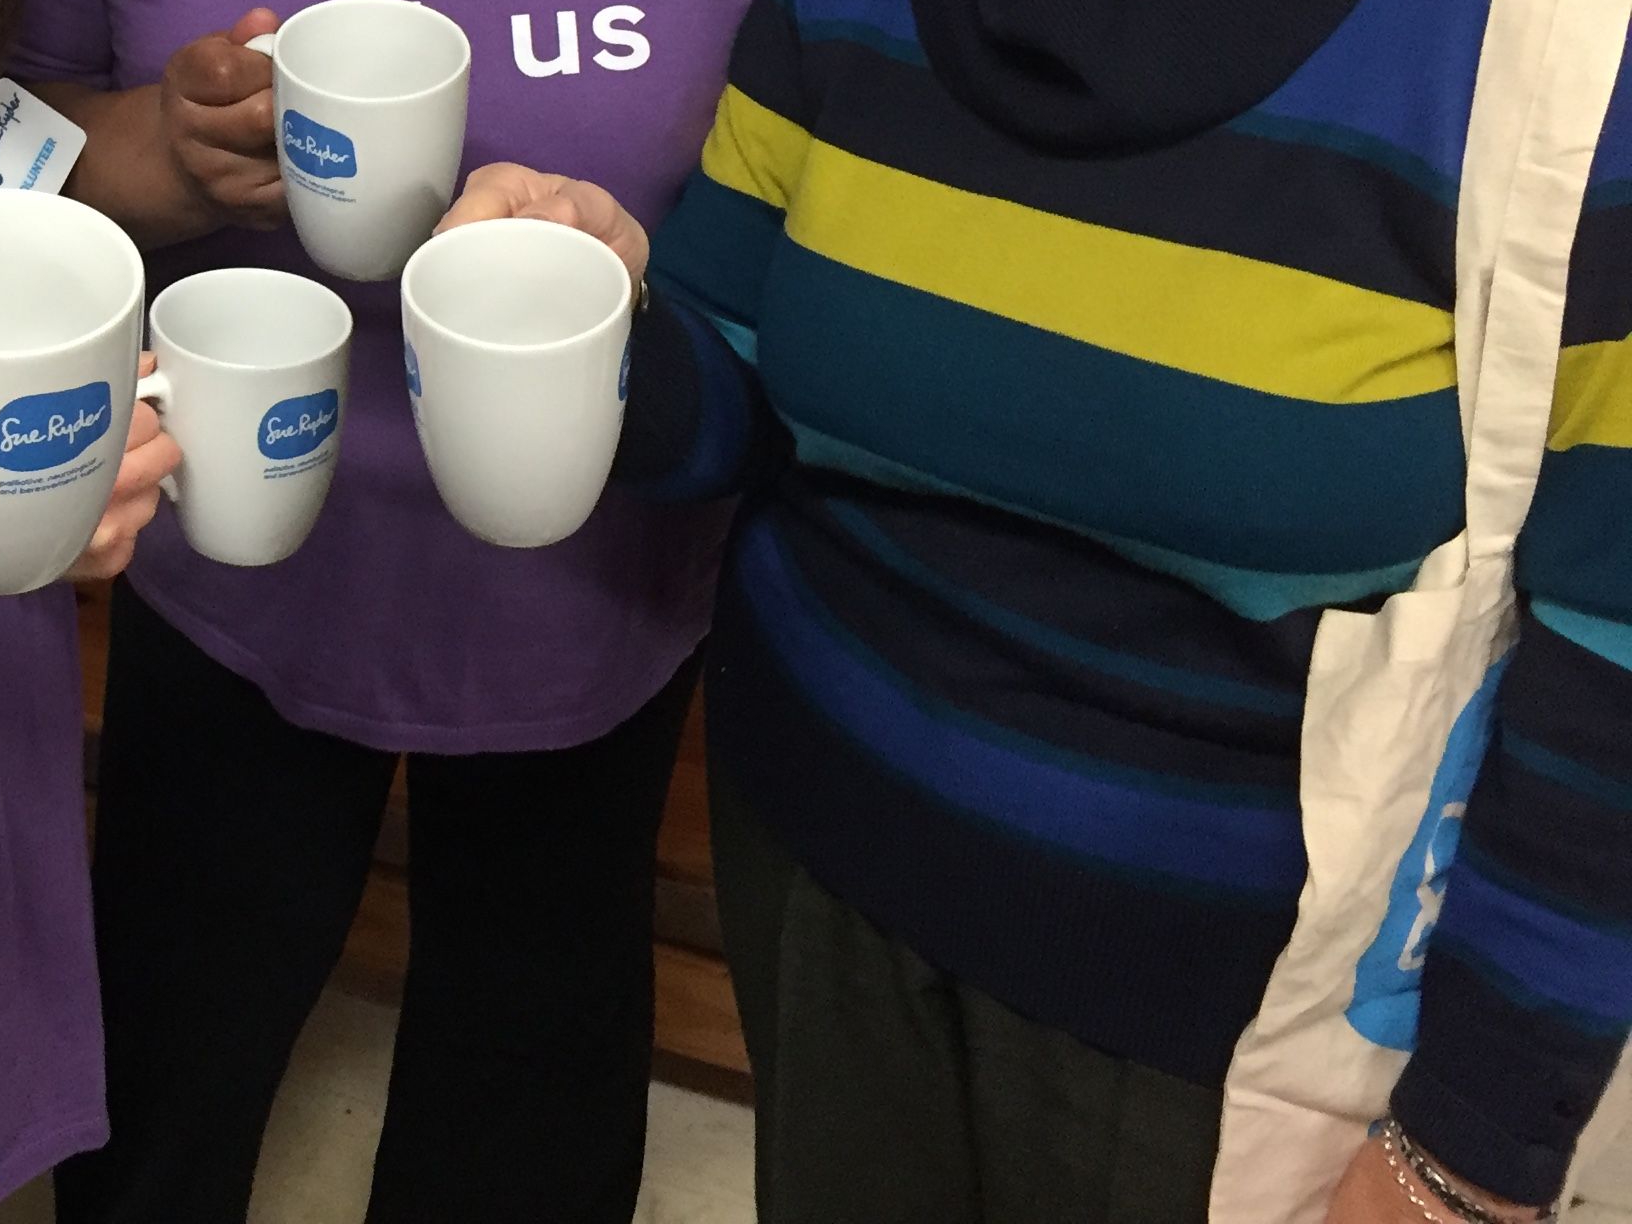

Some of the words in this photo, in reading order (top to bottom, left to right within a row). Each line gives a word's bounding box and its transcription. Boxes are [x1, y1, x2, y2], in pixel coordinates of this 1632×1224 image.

[511, 4, 651, 78] us
[19, 137, 57, 190] LUNTEER
[305, 136, 350, 166] Ryder
[0, 417, 47, 452] Sue
[47, 404, 106, 444] Ryder
[266, 416, 298, 444] Sue
[298, 408, 336, 436] Ryder
[0, 487, 17, 495] and
